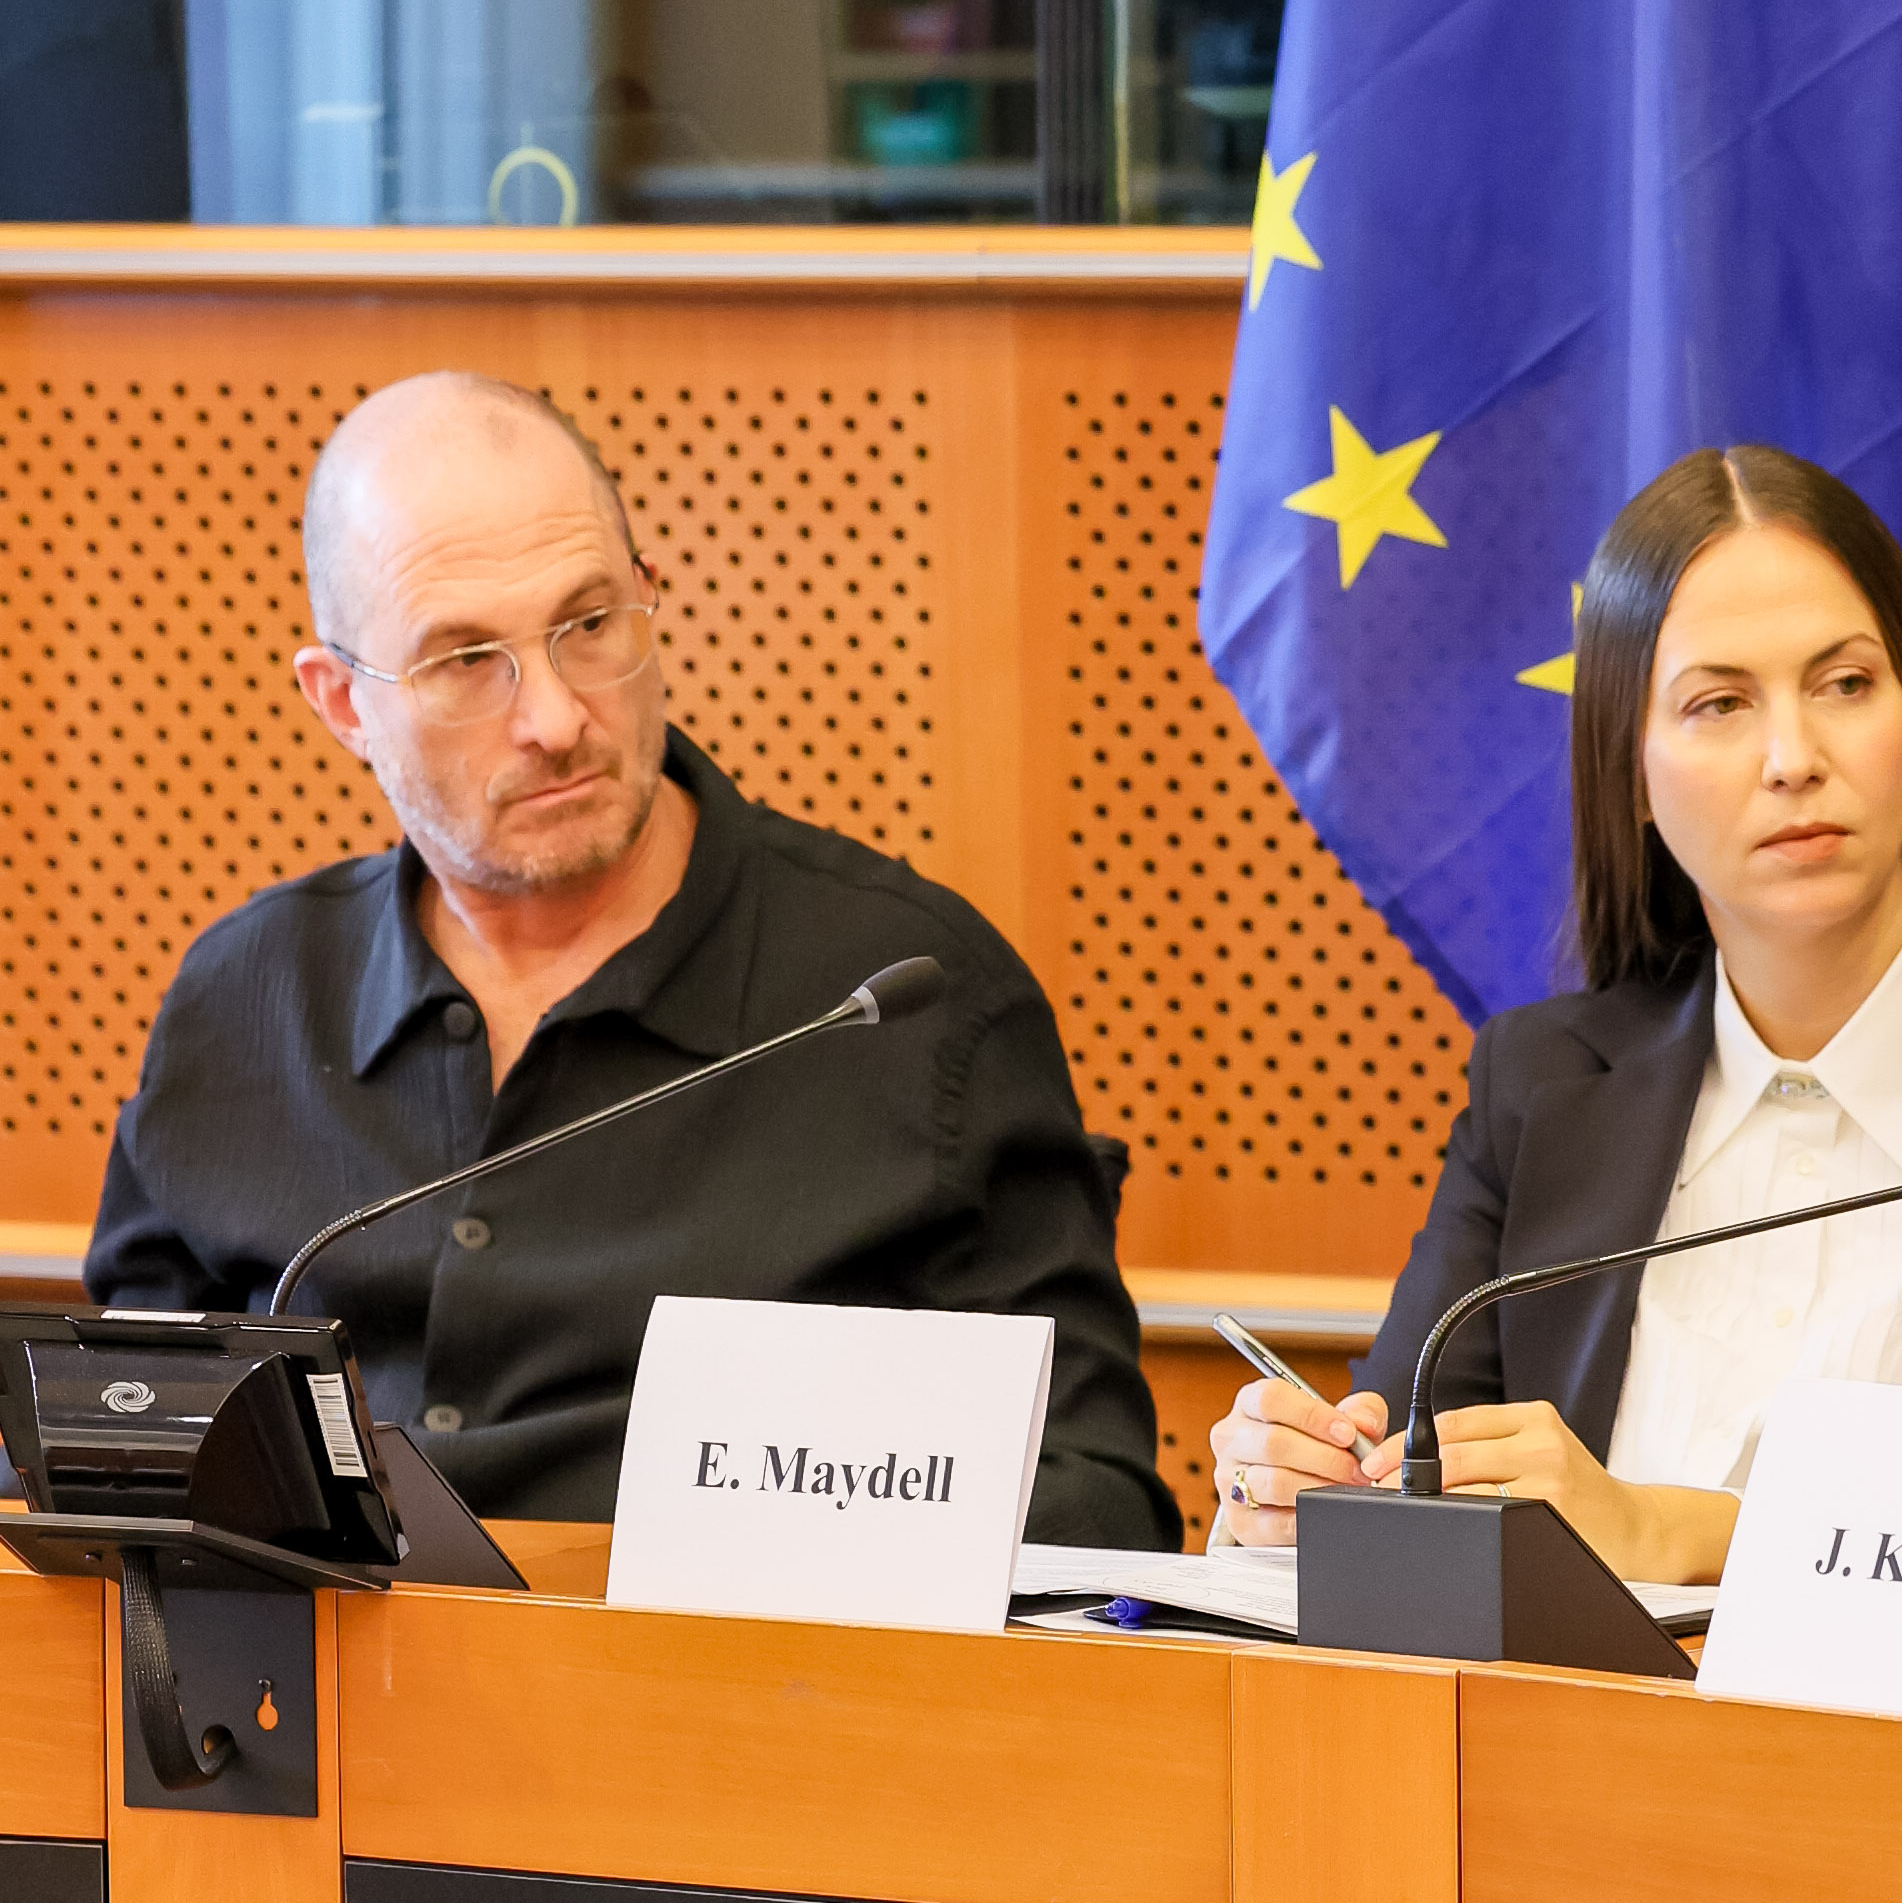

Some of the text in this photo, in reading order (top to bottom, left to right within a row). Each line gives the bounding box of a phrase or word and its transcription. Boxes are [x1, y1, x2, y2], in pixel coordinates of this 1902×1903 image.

[692, 1440, 955, 1510] E. Maydell
[1815, 1527, 1852, 1578] J.
